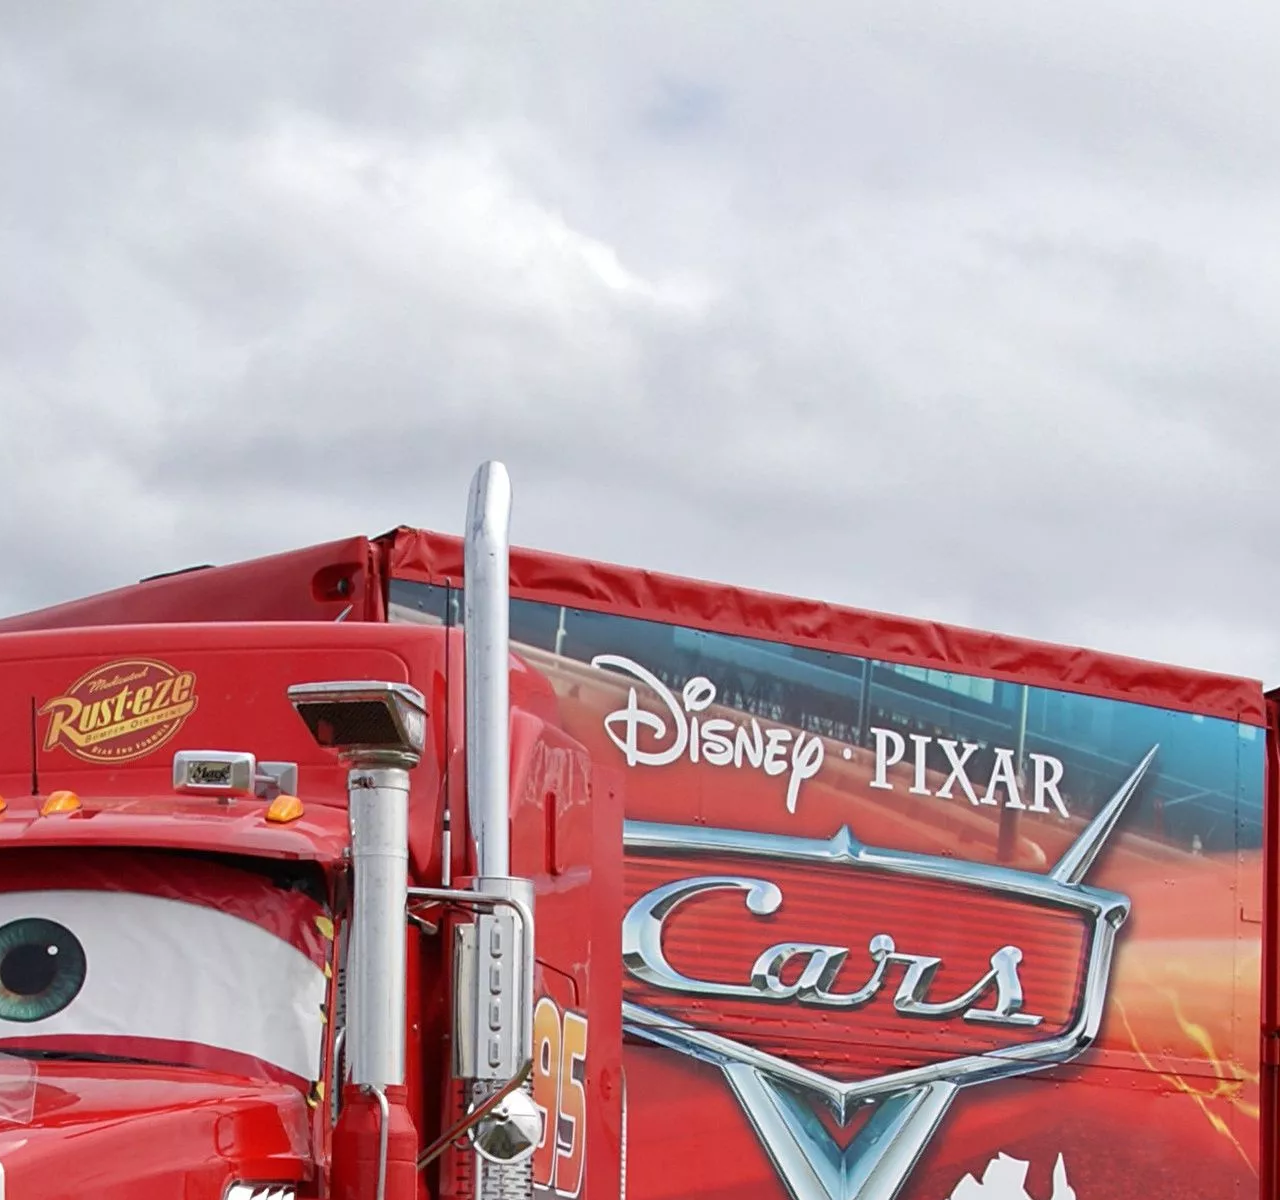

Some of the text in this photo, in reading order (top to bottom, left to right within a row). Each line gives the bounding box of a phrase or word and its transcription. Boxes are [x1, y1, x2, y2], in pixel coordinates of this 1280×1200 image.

[590, 655, 1070, 818] Disney PIXAR
[622, 876, 1045, 1026] Cars
[534, 997, 588, 1199] 95
